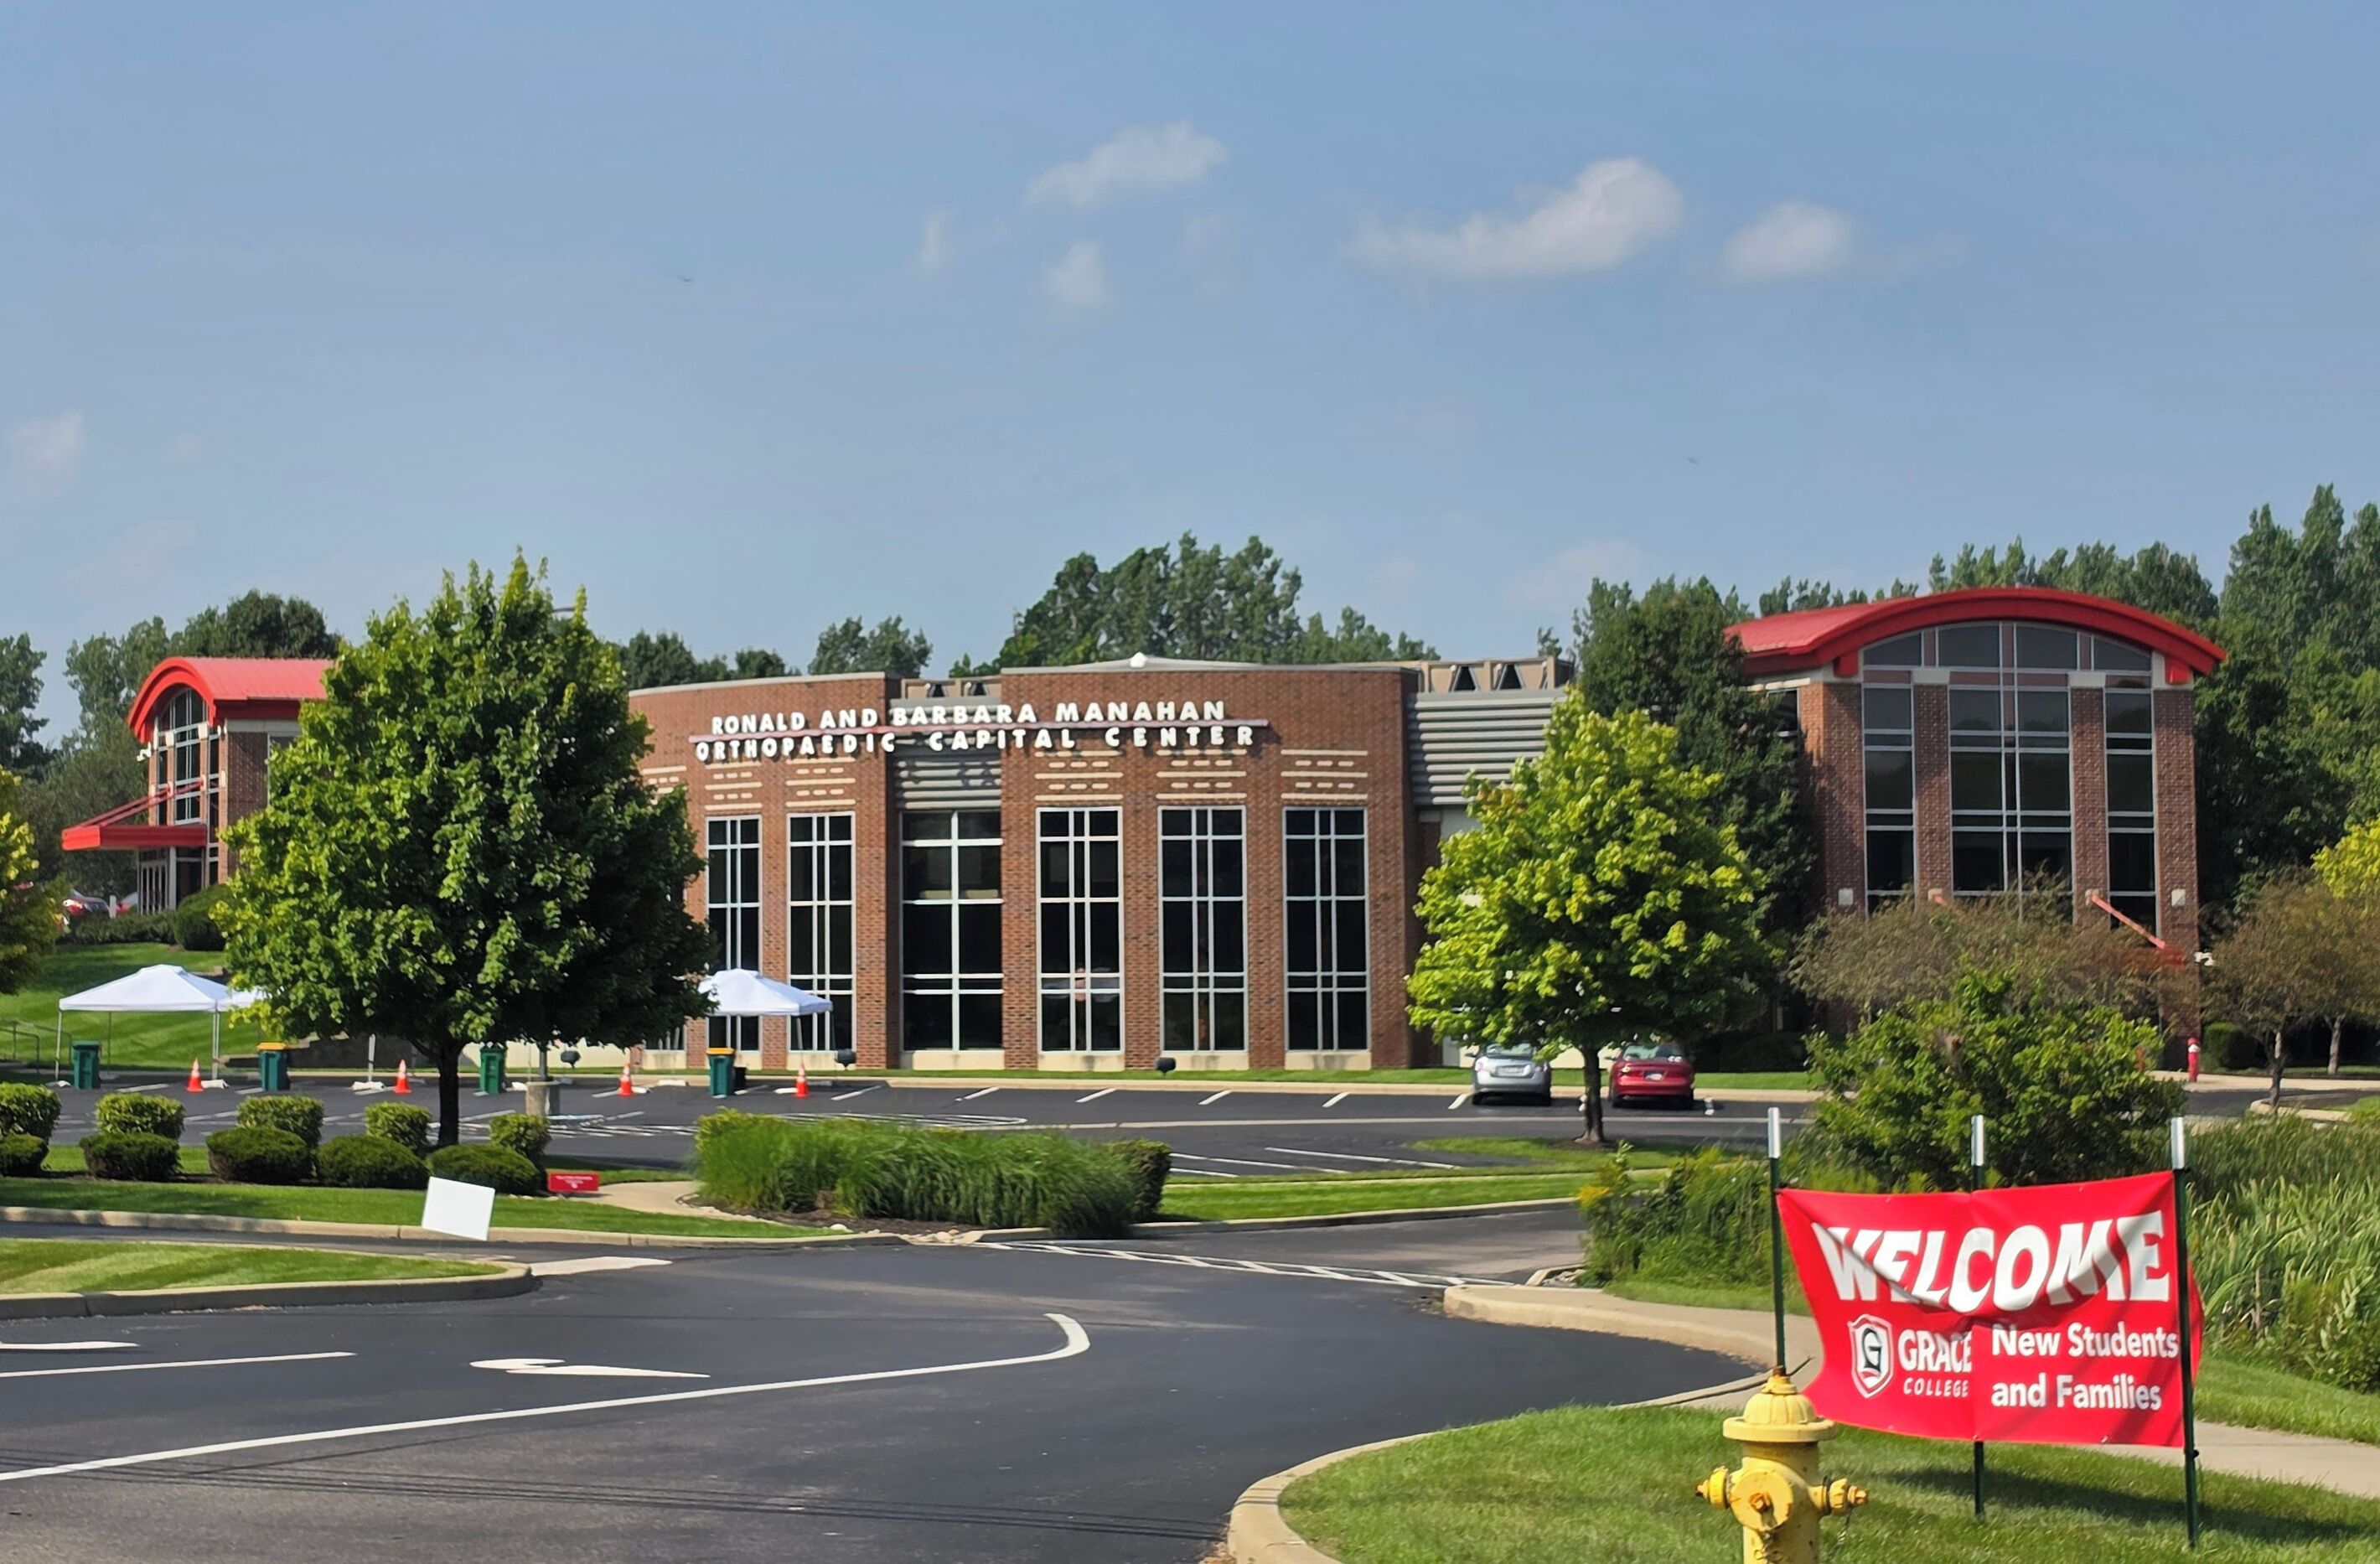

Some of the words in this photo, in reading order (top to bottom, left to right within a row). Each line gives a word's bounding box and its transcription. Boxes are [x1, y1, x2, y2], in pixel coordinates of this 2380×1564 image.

[711, 711, 806, 735] RONALD
[820, 708, 878, 728] AND
[893, 705, 1037, 727] BARBARA
[1055, 701, 1224, 722] MANAHAN
[696, 733, 895, 761] ORTHOPAEDIC
[930, 729, 1075, 751] CAPITAL
[1105, 726, 1253, 748] CENTER
[1812, 1210, 2170, 1313] WELCOME
[1897, 1328, 1973, 1373] GRACE
[1991, 1323, 2060, 1357] New
[2067, 1321, 2179, 1359] Students
[1903, 1377, 1969, 1398] COLLEGE
[1991, 1372, 2046, 1408] and
[2057, 1373, 2161, 1411] Families
